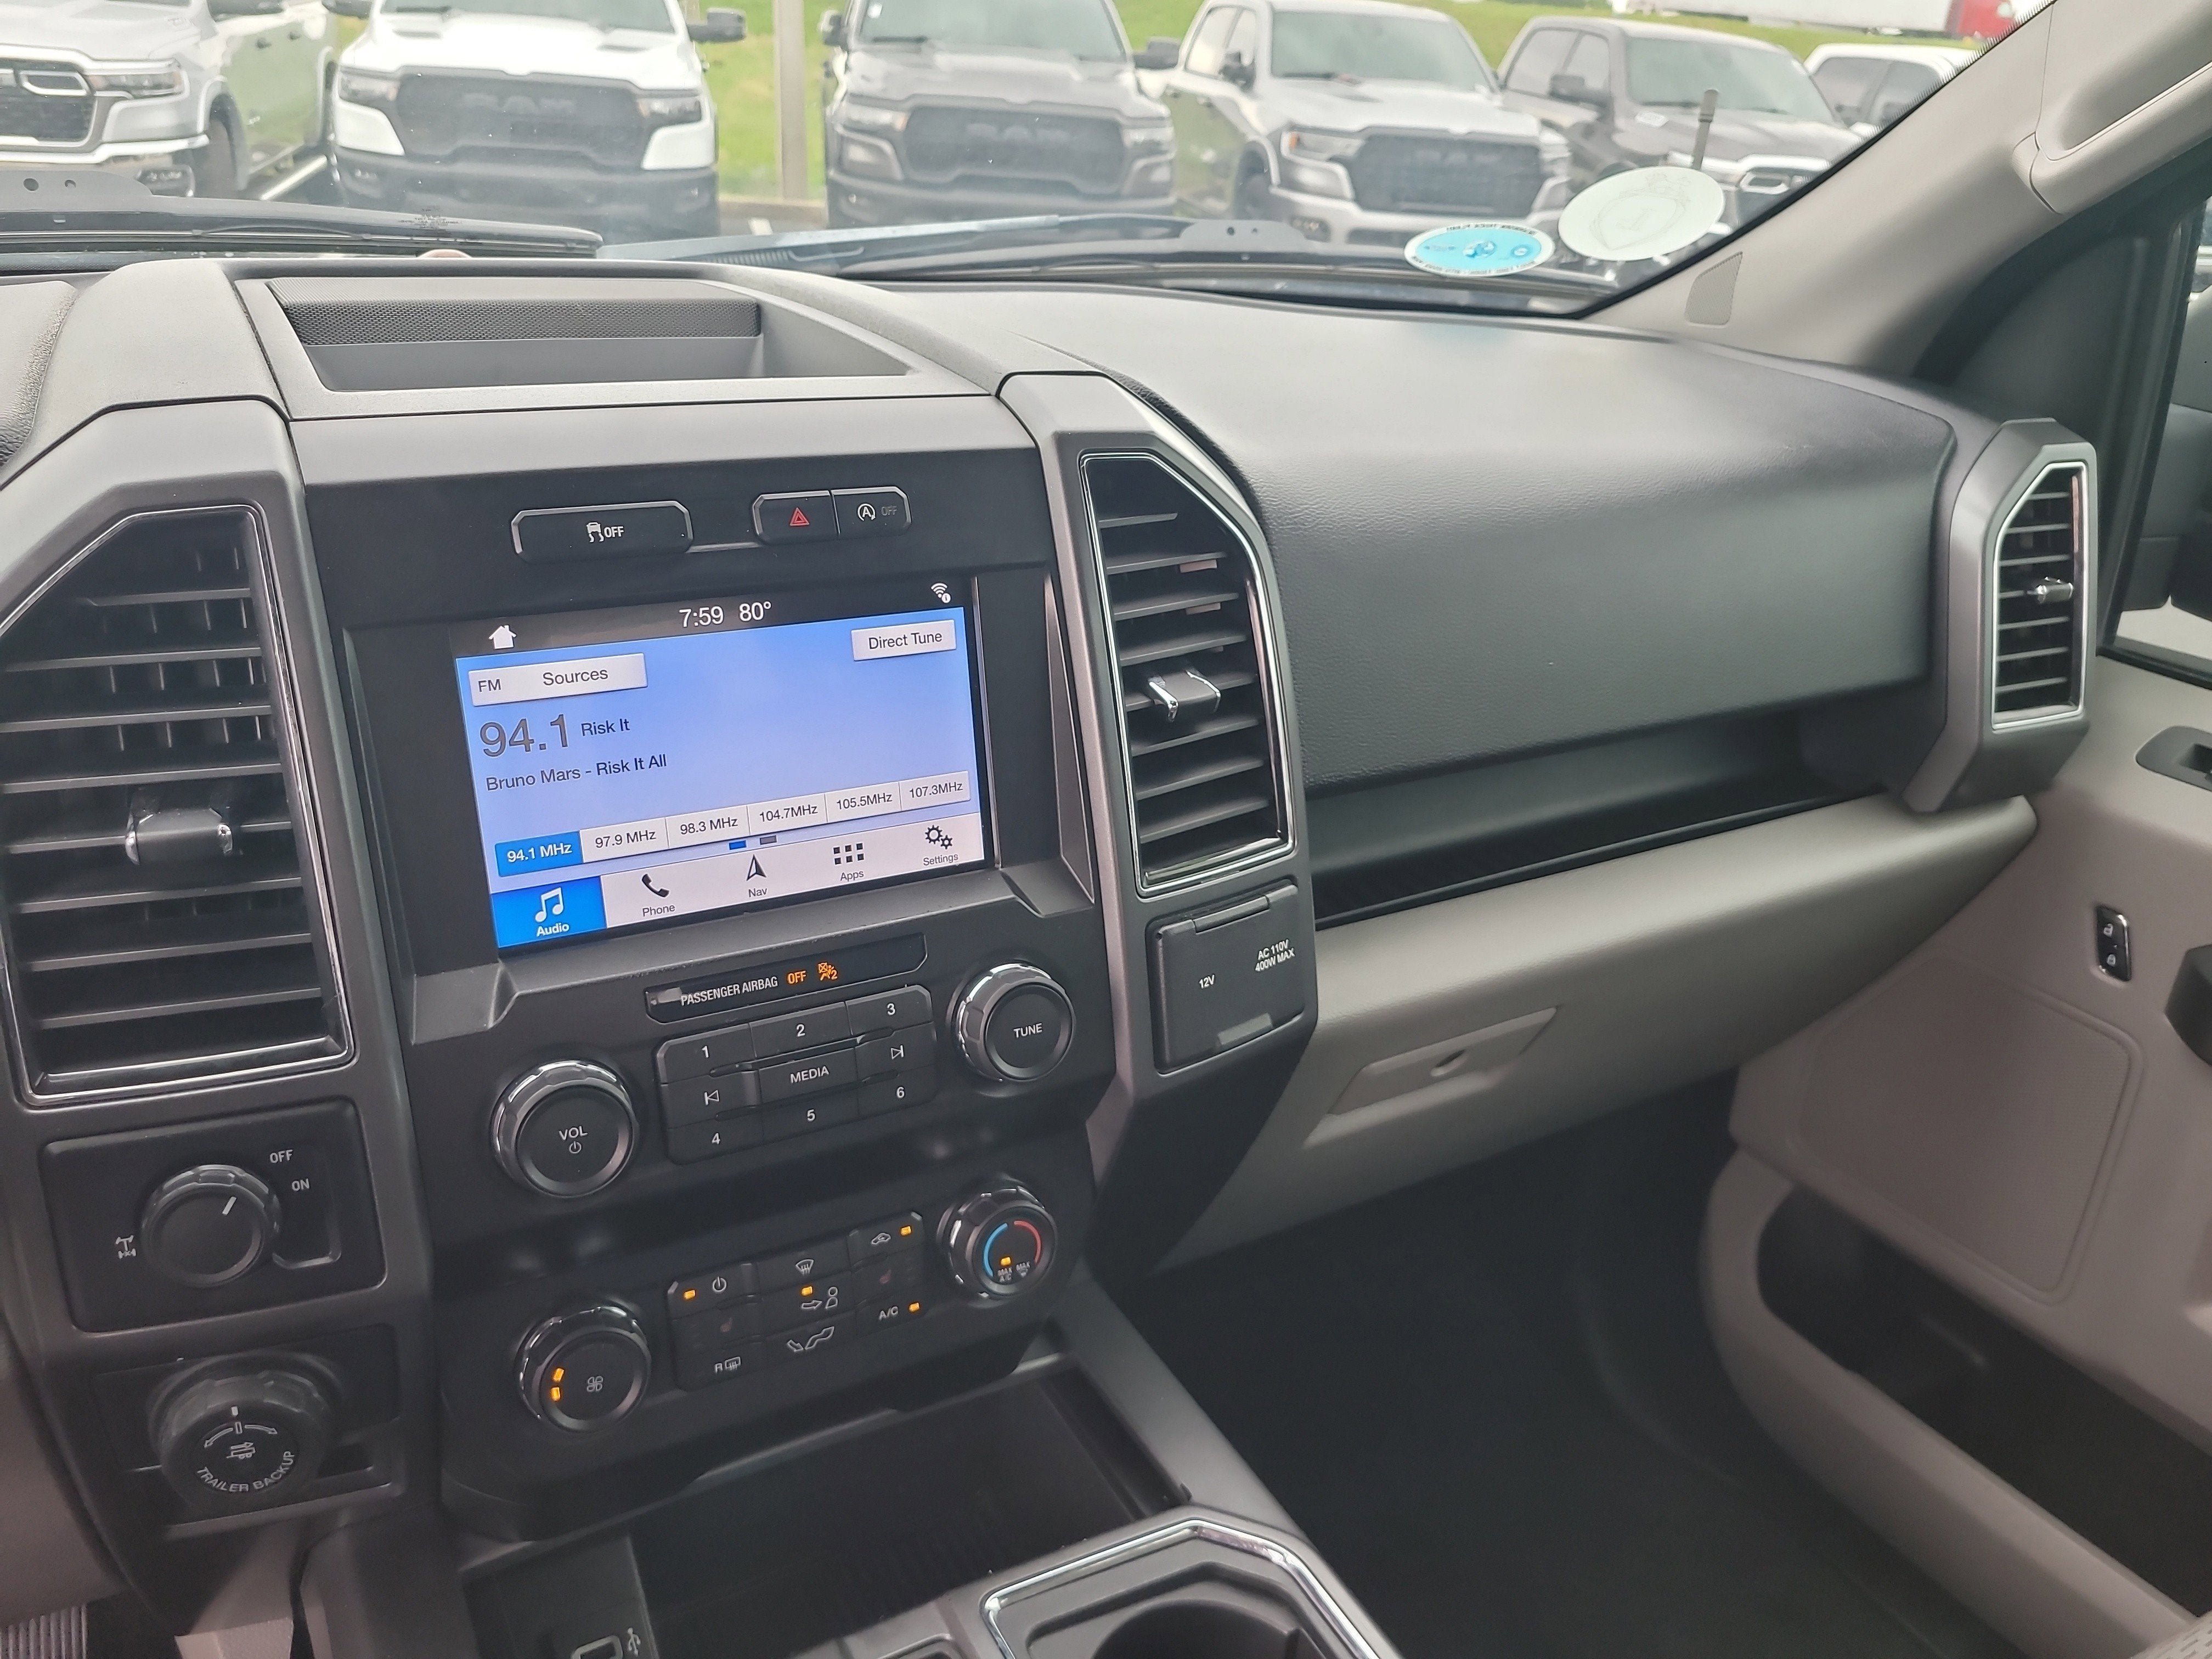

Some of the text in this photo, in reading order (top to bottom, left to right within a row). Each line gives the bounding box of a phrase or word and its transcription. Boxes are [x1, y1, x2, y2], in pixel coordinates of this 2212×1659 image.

[881, 505, 898, 516] OFF
[605, 525, 624, 537] OFF
[679, 601, 772, 627] 7:59 80°
[867, 628, 943, 649] Direct Tune
[478, 665, 608, 692] FM Sources
[581, 717, 630, 736] Risk It
[479, 713, 569, 756] 94.1
[487, 771, 537, 792] Bruno
[540, 766, 581, 784] Mars
[595, 760, 630, 777] Risk
[633, 757, 645, 772] It
[647, 754, 667, 769] All
[909, 779, 963, 799] 107.3MHz
[836, 791, 893, 811] 105.5MHz
[759, 803, 819, 823] 104.7MHz
[679, 817, 738, 835] 98.3 MHz
[594, 828, 657, 848] 97.9 MHz
[506, 843, 572, 862] 94.1 MHz
[922, 851, 959, 866] Settings
[839, 869, 865, 883] Apps
[748, 886, 769, 898] Nav
[641, 902, 676, 917] Phone
[537, 921, 569, 936] Audio
[1259, 940, 1289, 958] AC 110V
[1255, 948, 1295, 971] 400W MAX
[787, 970, 806, 984] OFF
[1199, 974, 1215, 988] 12V
[681, 977, 778, 1005] PASSENGER AIRBAG
[887, 1003, 895, 1015] 3
[796, 1025, 805, 1036] 2
[1013, 1023, 1043, 1038] TUNE
[702, 1046, 709, 1057] 1
[791, 1066, 830, 1082] MEDIA
[896, 1087, 905, 1098] 6
[807, 1110, 815, 1120] 5
[559, 1125, 588, 1140] VOL
[712, 1133, 720, 1144] 4
[270, 1149, 293, 1163] OFF
[292, 1178, 310, 1190] ON
[879, 1305, 899, 1319] A/C
[715, 1363, 723, 1373] R
[197, 1451, 295, 1492] TRAILER BACKUP
